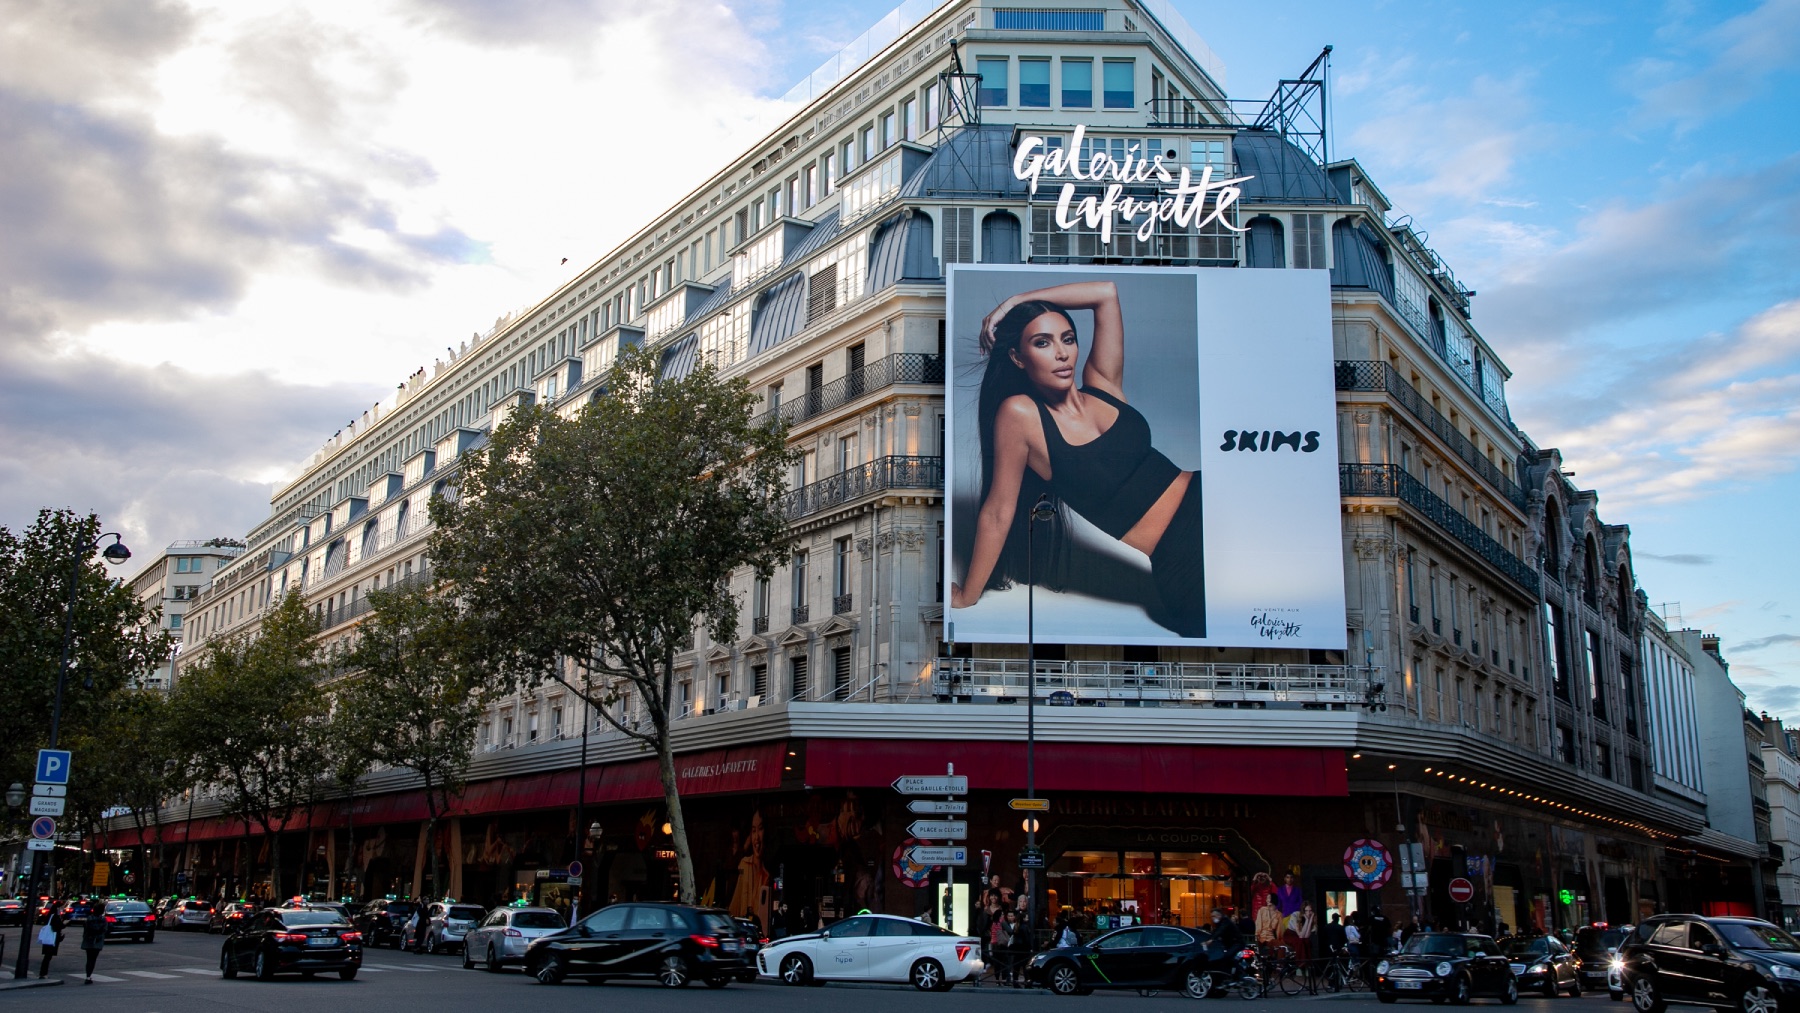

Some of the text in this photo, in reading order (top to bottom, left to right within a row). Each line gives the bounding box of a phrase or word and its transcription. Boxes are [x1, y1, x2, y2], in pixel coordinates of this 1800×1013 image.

[1013, 124, 1172, 195] Galeries
[1056, 166, 1255, 244] Lafayette
[1220, 430, 1320, 452] SKIMS
[1251, 613, 1285, 629] Galeries
[1260, 622, 1303, 640] Lafayette
[45, 756, 61, 777] P
[682, 760, 757, 778] GALERIES LAFAYETTE
[1137, 834, 1227, 843] LA COUPOLE
[656, 850, 676, 858] METR
[835, 956, 853, 964] hype
